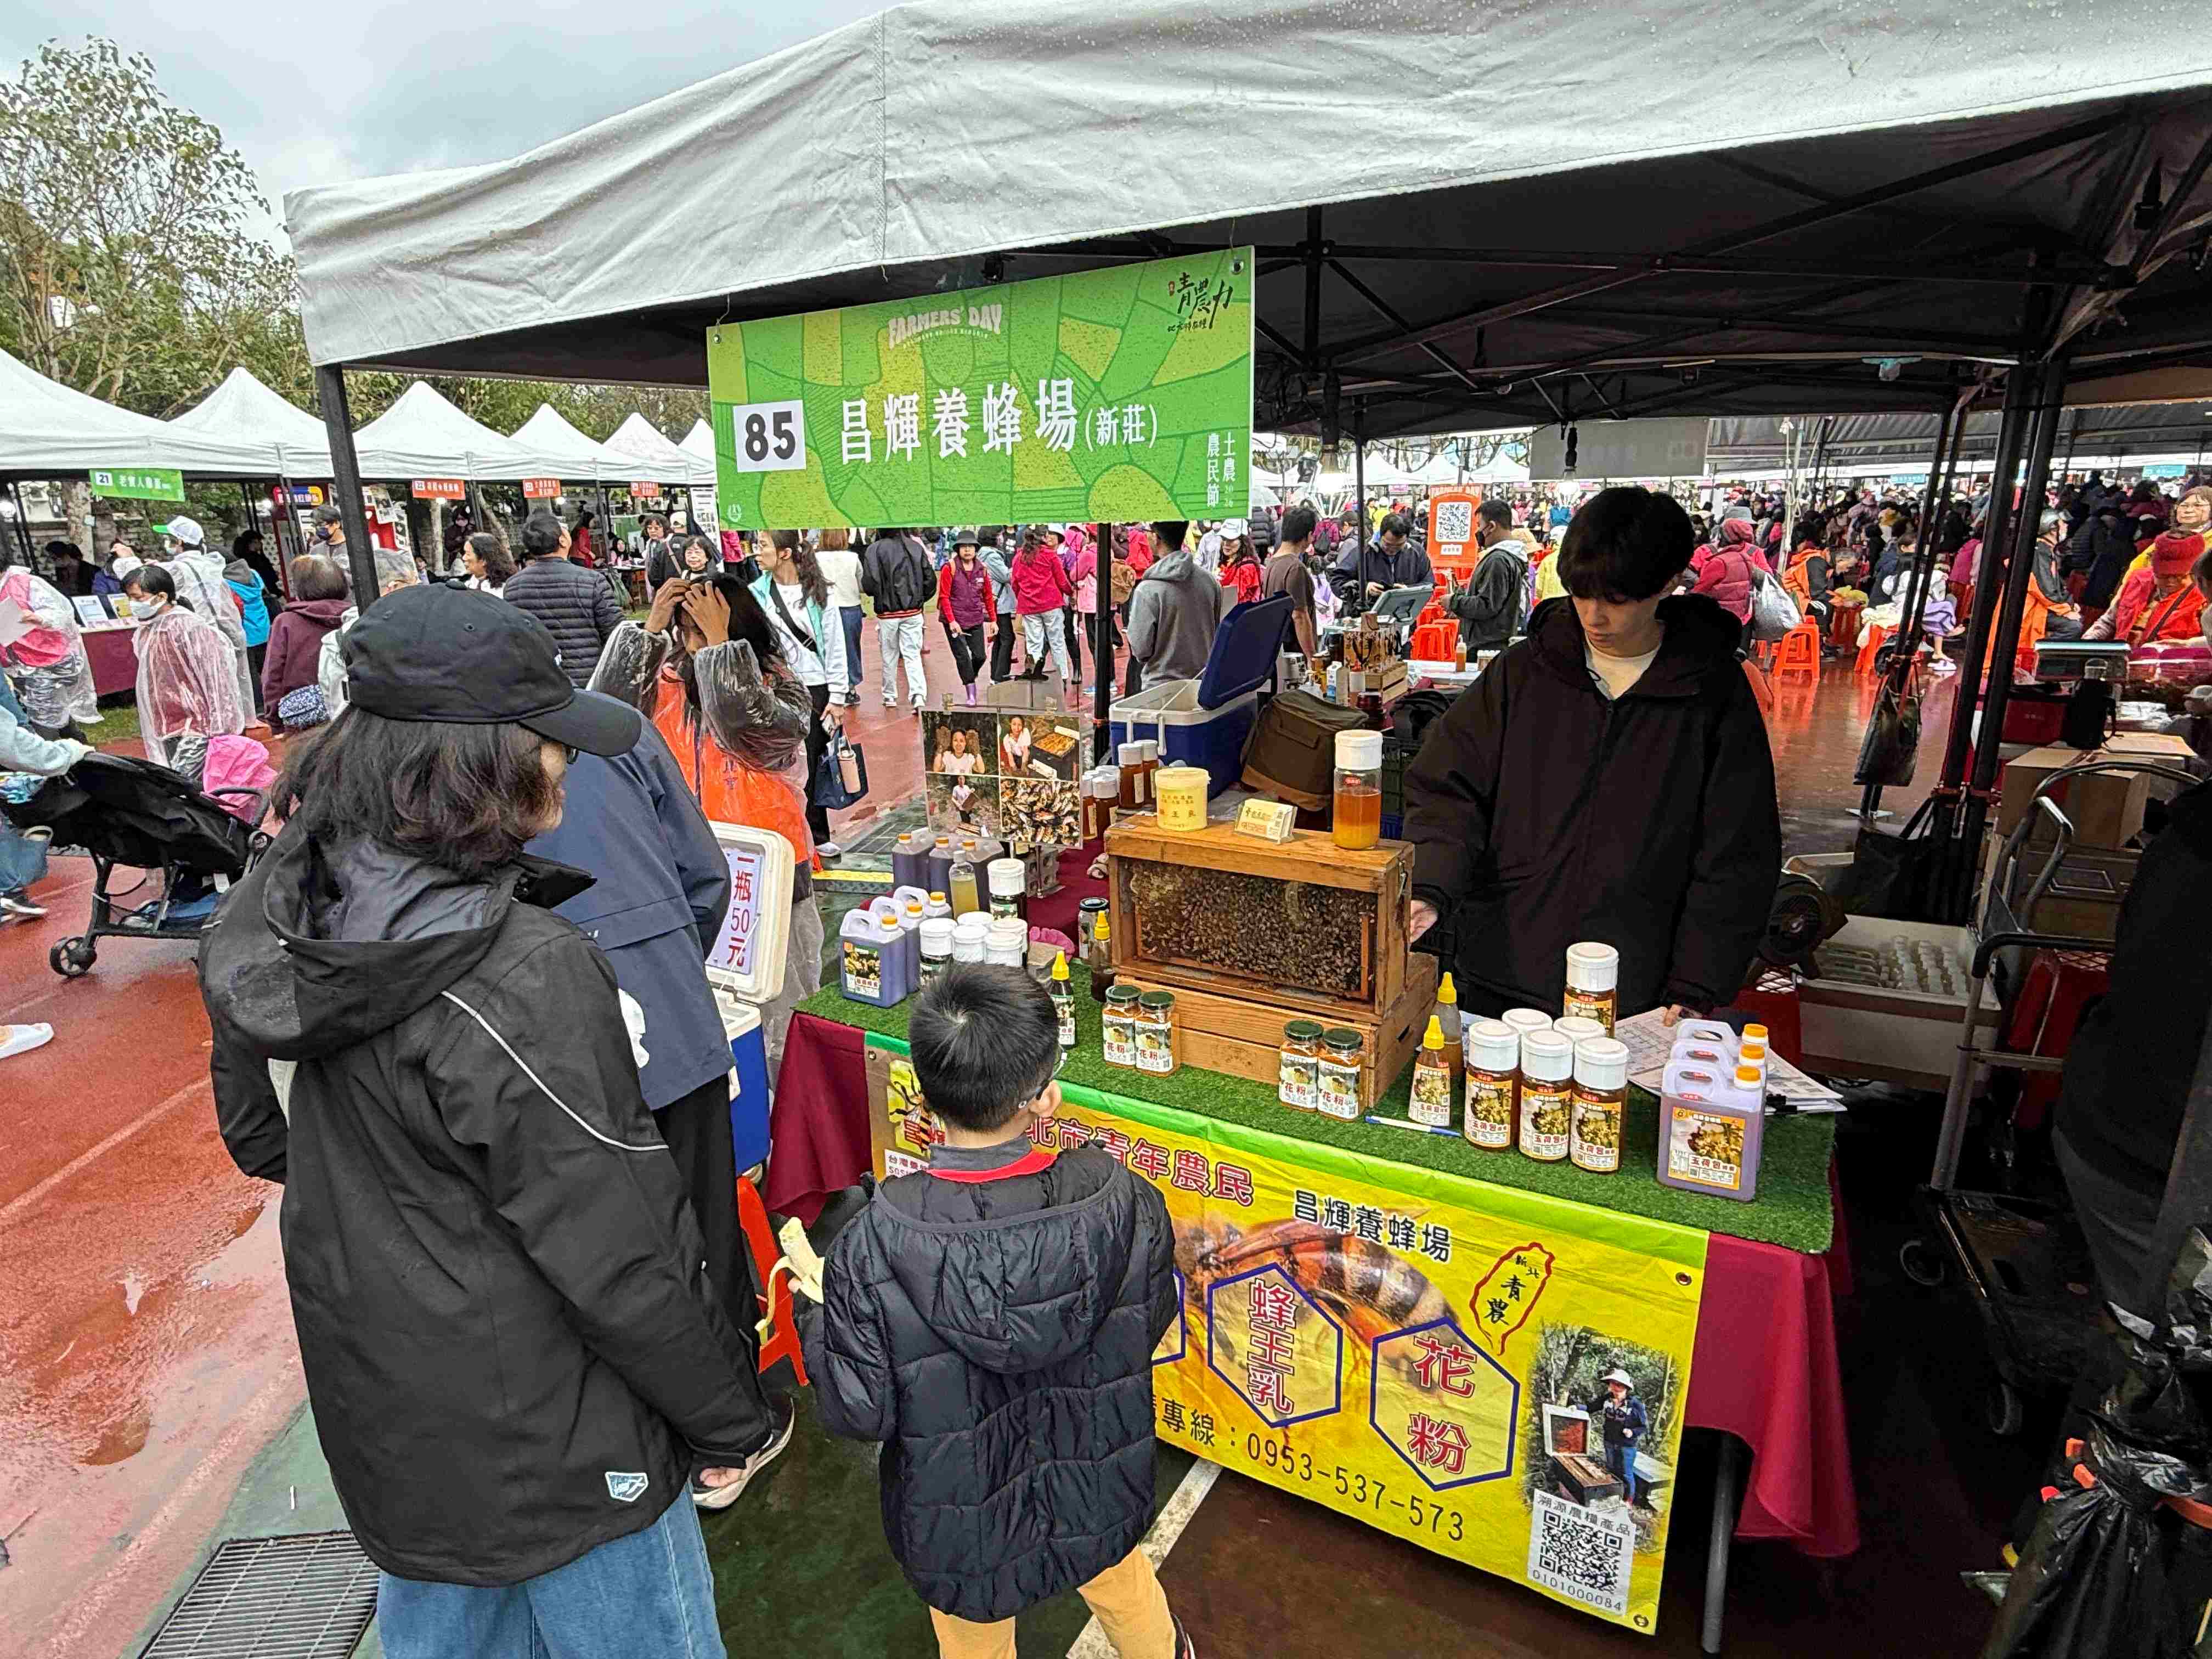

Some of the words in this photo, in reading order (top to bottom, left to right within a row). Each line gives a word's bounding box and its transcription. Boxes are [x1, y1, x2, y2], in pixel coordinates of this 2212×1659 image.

[888, 306, 964, 351] FARMERS'
[968, 303, 1002, 335] DAY
[745, 410, 796, 462] 85
[1222, 431, 1236, 482] 士農
[99, 474, 109, 484] 21
[1207, 432, 1221, 507] 農民節
[1285, 1081, 1306, 1096] 花粉
[1323, 1091, 1344, 1106] 花粉
[1294, 1189, 1452, 1263] 昌輝養蜂場
[1515, 1254, 1540, 1279] 新北
[1483, 1274, 1527, 1326] 青農
[1246, 1278, 1297, 1415] 蜂王乳
[1407, 1335, 1477, 1475] 花粉
[1533, 1569, 1622, 1611] 0101000084
